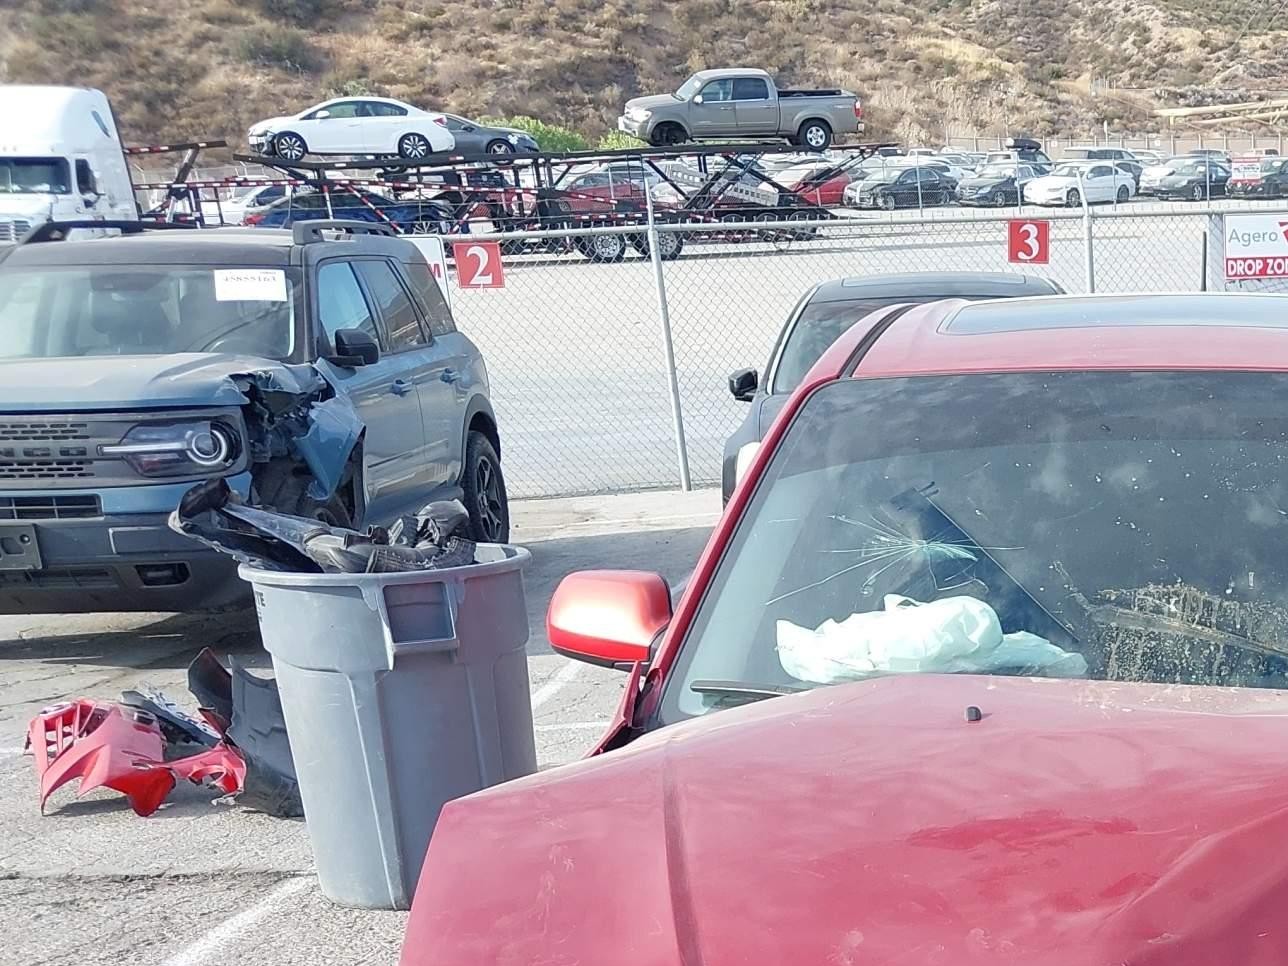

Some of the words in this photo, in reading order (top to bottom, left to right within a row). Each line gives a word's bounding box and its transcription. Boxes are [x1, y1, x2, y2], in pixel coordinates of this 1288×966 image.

[1017, 223, 1040, 260] 3
[1228, 228, 1279, 247] Agero
[466, 245, 493, 285] 2
[1227, 259, 1264, 276] DROP
